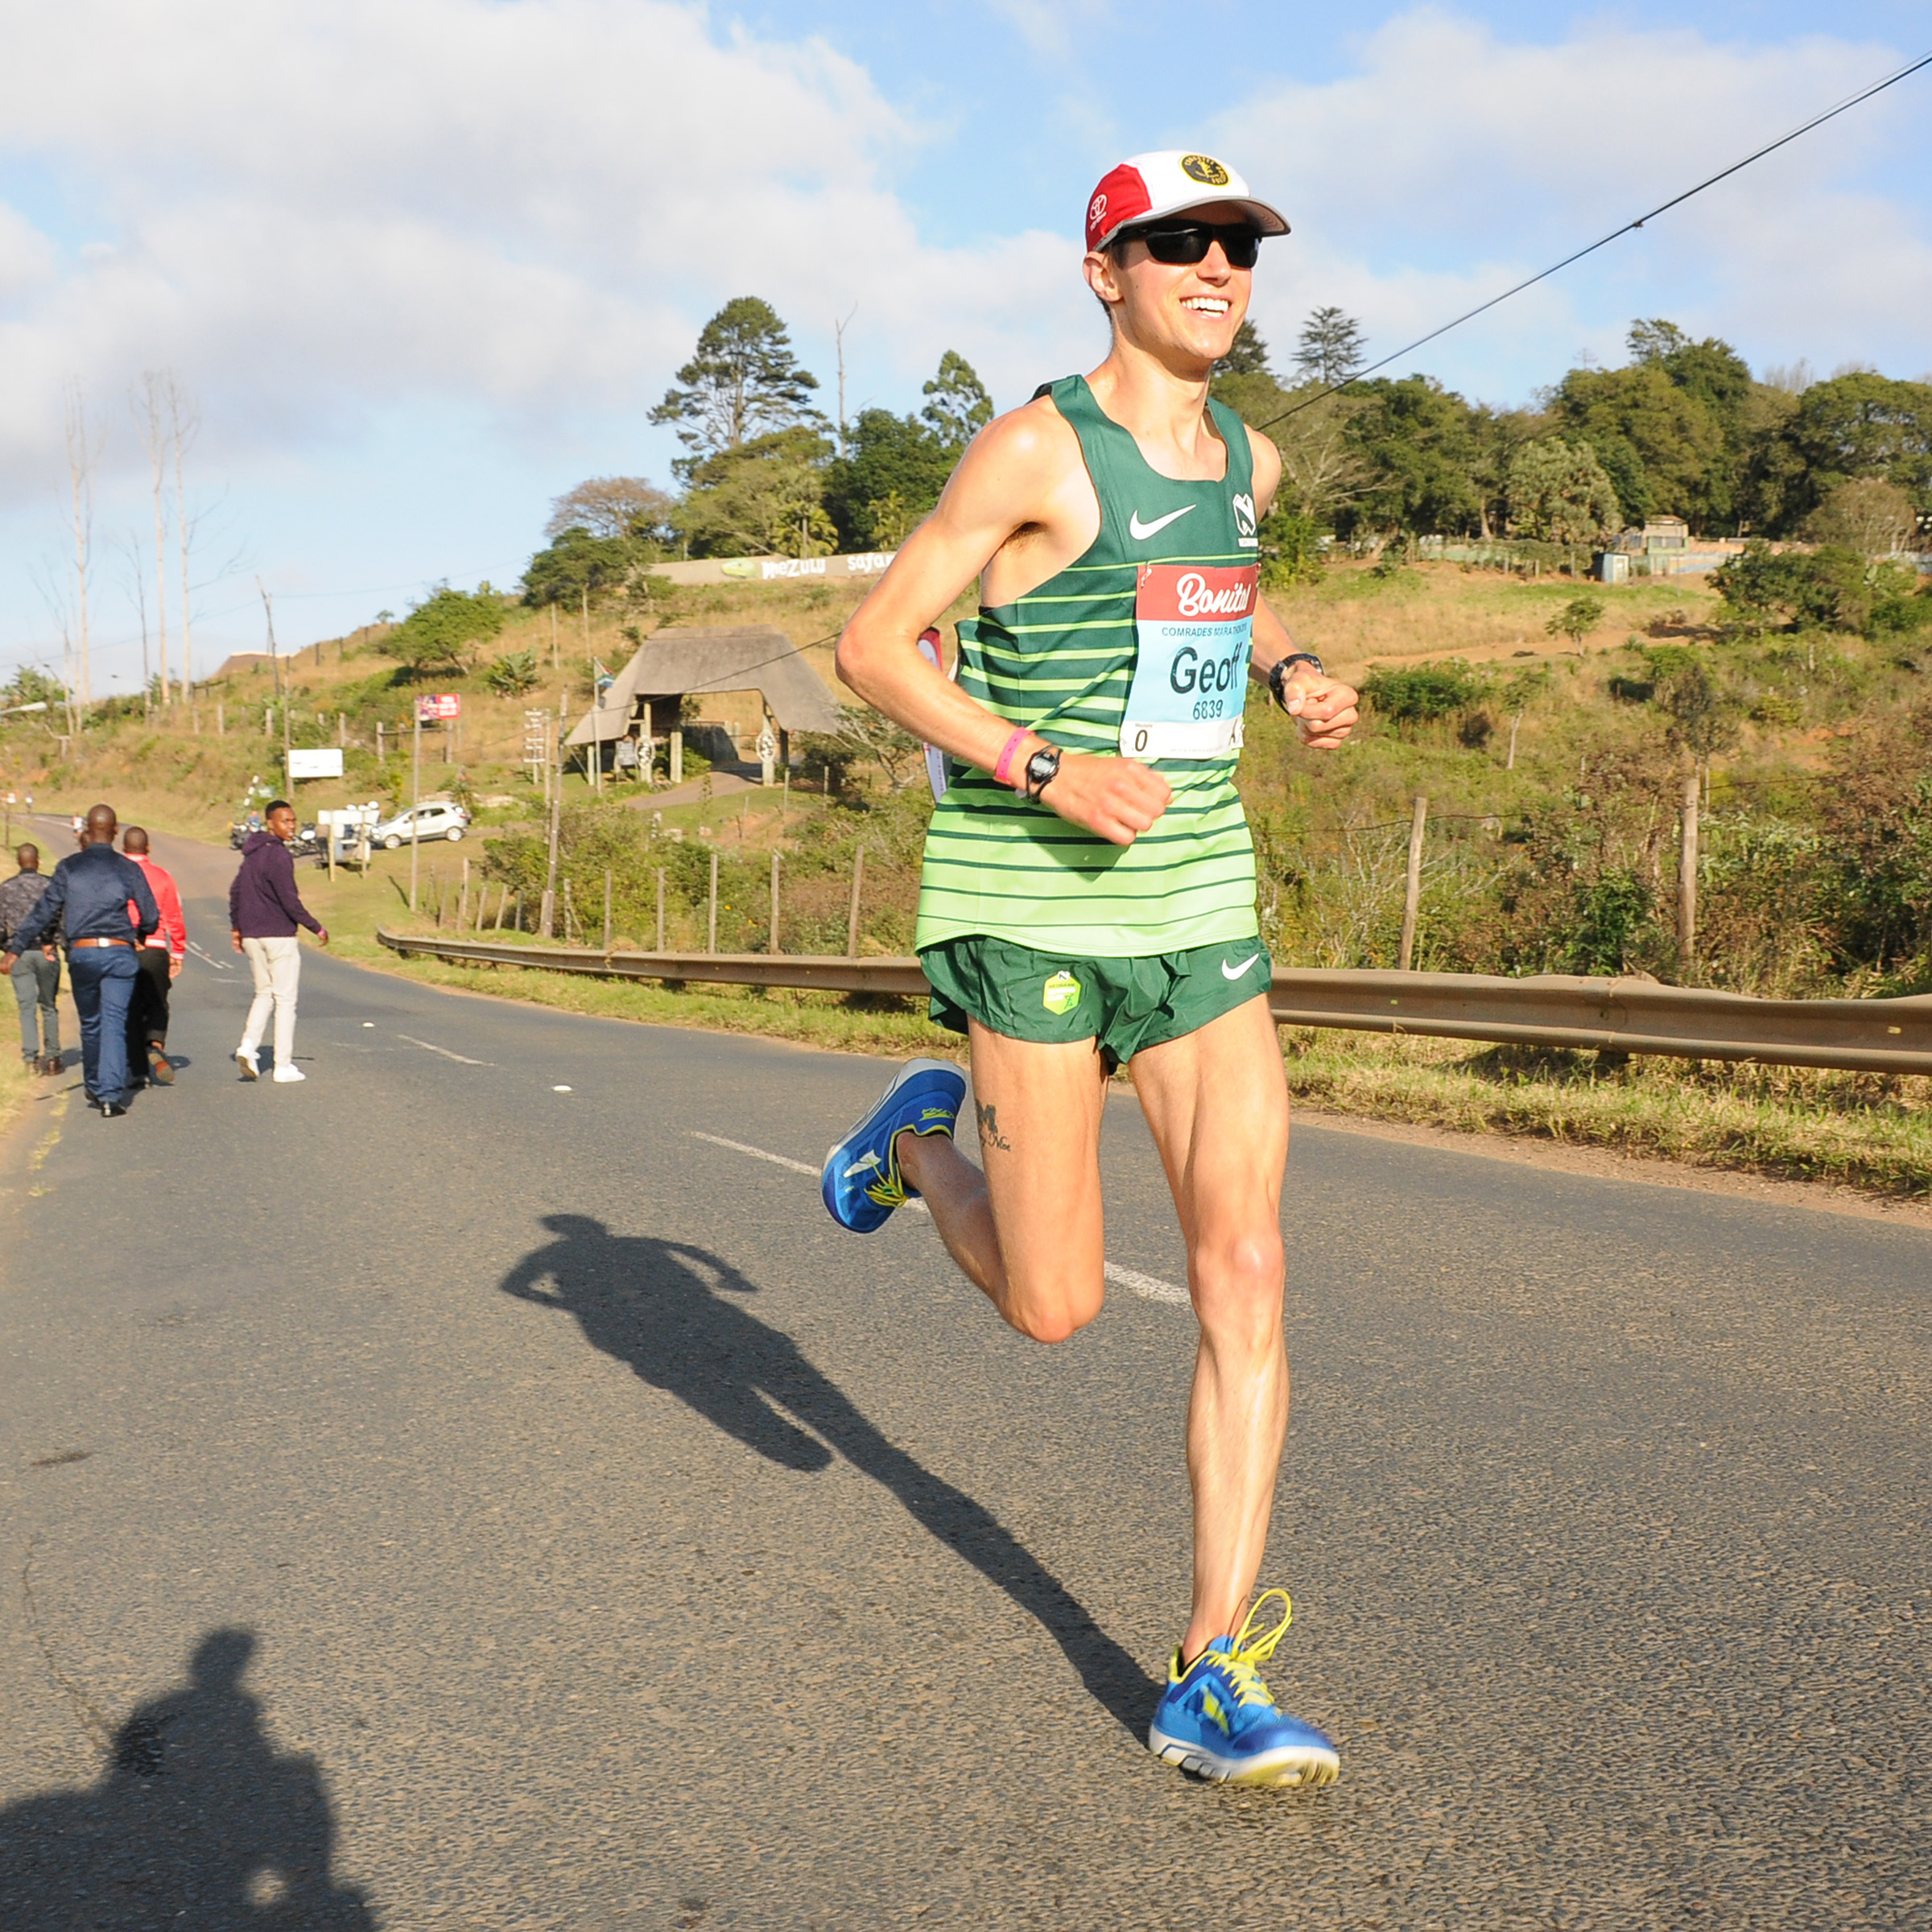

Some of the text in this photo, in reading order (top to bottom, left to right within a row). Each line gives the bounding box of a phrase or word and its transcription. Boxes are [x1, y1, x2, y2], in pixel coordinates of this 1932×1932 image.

[1162, 627, 1212, 637] COMRADES
[1170, 642, 1242, 694] Geoff
[1193, 699, 1224, 720] 6839
[1135, 729, 1148, 752] 0
